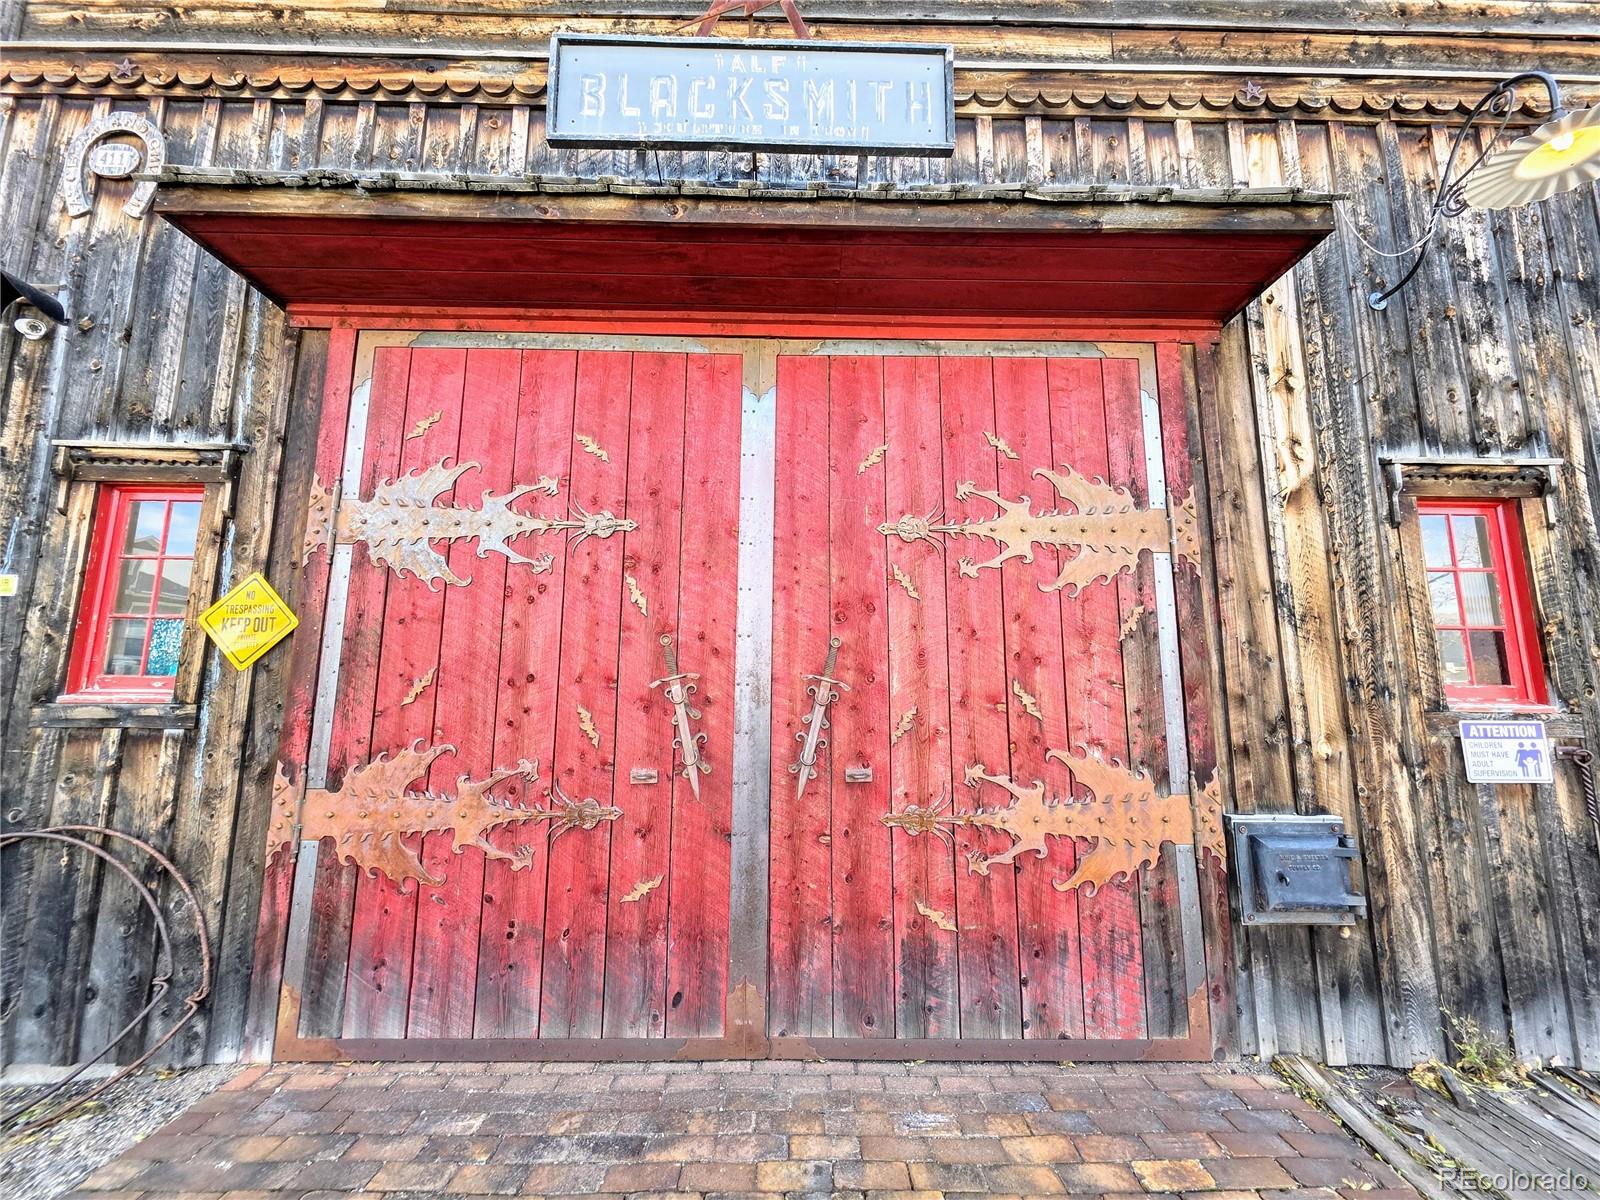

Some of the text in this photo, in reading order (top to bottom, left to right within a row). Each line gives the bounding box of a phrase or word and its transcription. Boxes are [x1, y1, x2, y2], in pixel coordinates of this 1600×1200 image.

[578, 71, 933, 126] BLACKSMITH
[100, 151, 125, 166] 411
[245, 590, 256, 601] NO
[225, 604, 275, 615] TRESPASSING
[221, 616, 277, 633] KEEP OUT
[1469, 725, 1537, 738] ATTENTION
[1468, 741, 1503, 749] CHILDREN
[1472, 760, 1494, 768] ADULT
[1473, 769, 1518, 777] SUPERVISION
